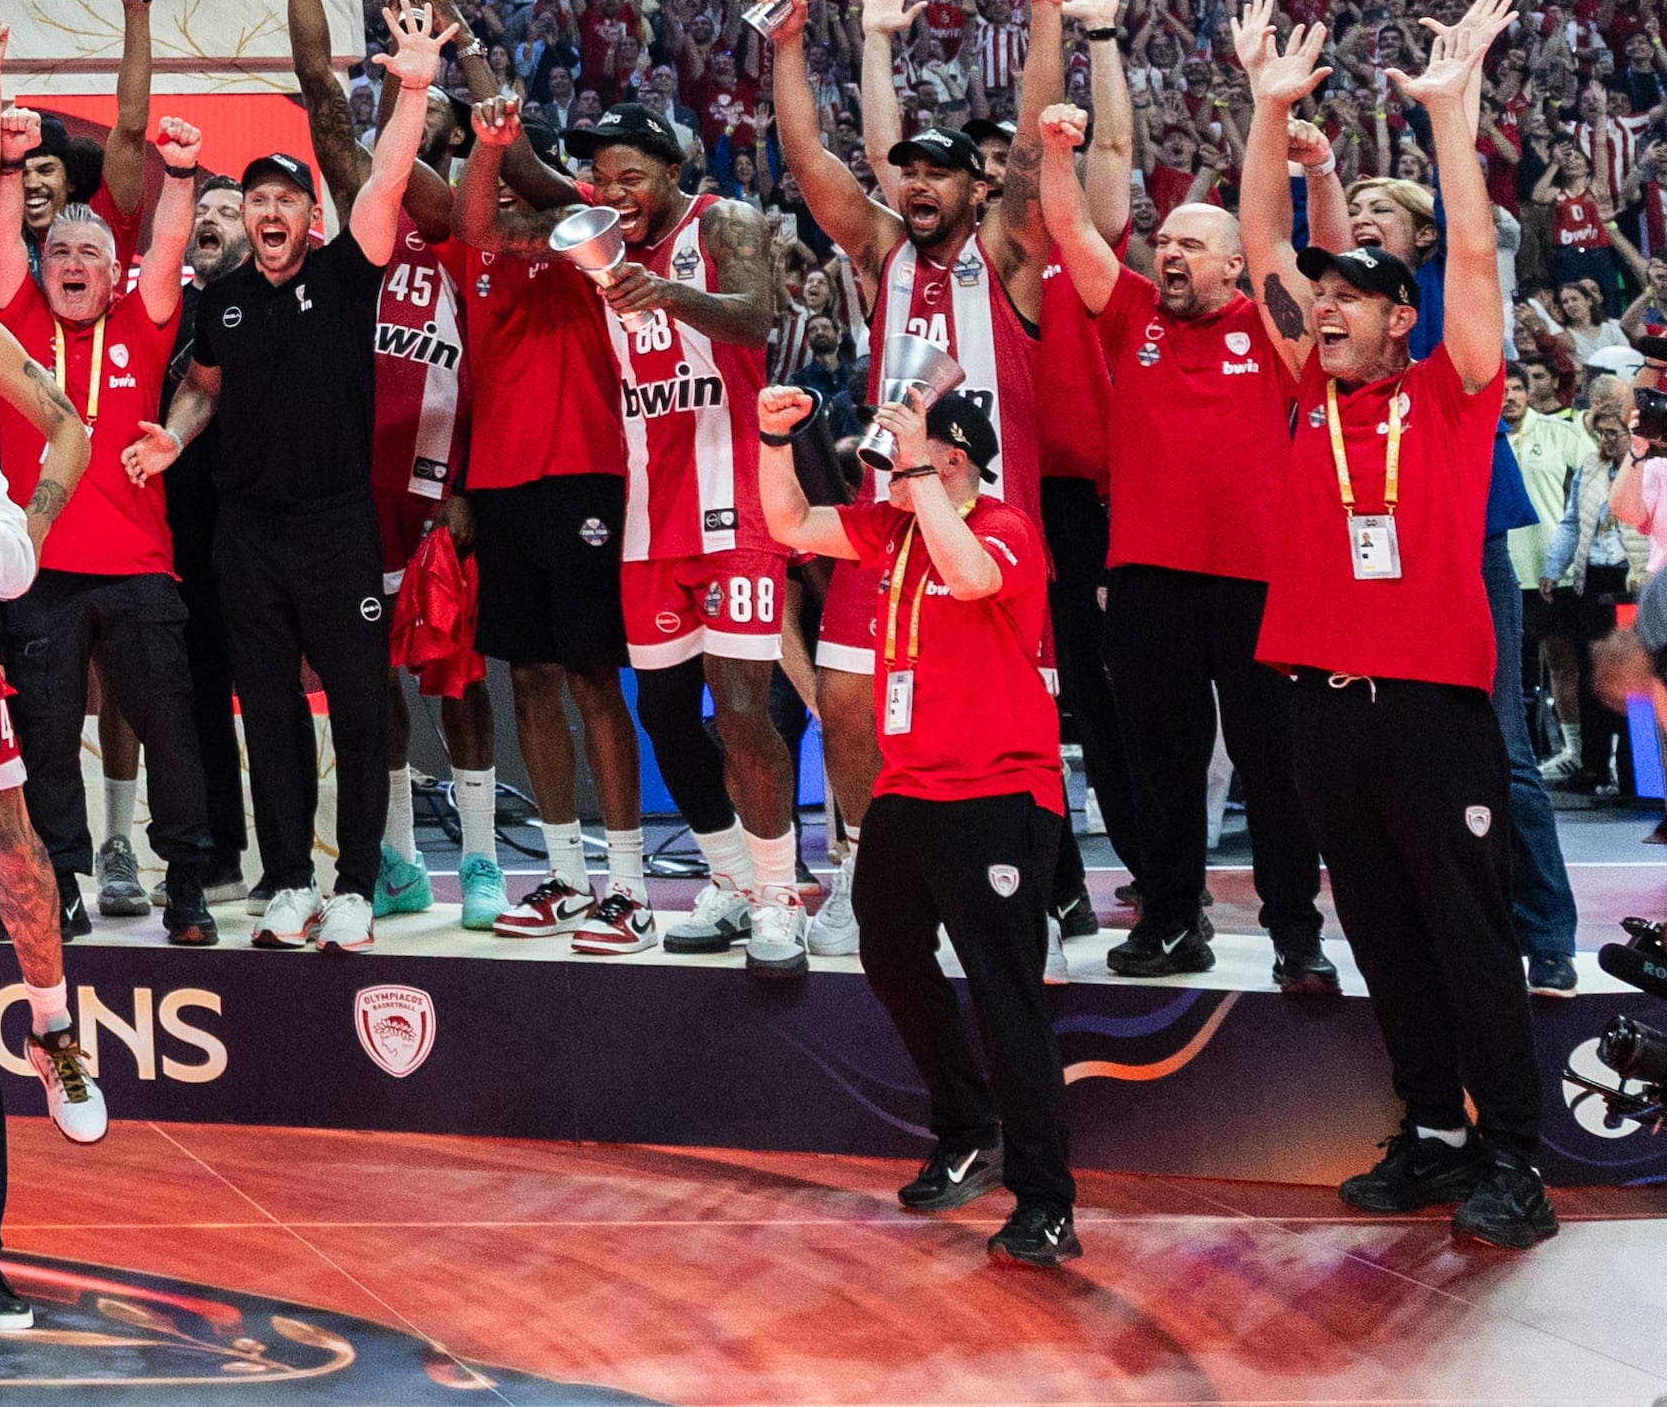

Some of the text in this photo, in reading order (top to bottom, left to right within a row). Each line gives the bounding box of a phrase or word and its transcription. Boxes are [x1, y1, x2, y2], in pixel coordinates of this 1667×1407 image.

[1560, 223, 1599, 245] bwin
[387, 263, 435, 308] 45
[635, 308, 672, 355] 88
[376, 321, 462, 371] win
[1222, 358, 1260, 376] bwin
[109, 373, 137, 389] bwin
[623, 362, 724, 418] bwin
[924, 580, 951, 596] bw
[729, 576, 774, 623] 88
[363, 991, 425, 1008] OLYMPIACOS
[371, 1000, 417, 1014] BASKETBALL
